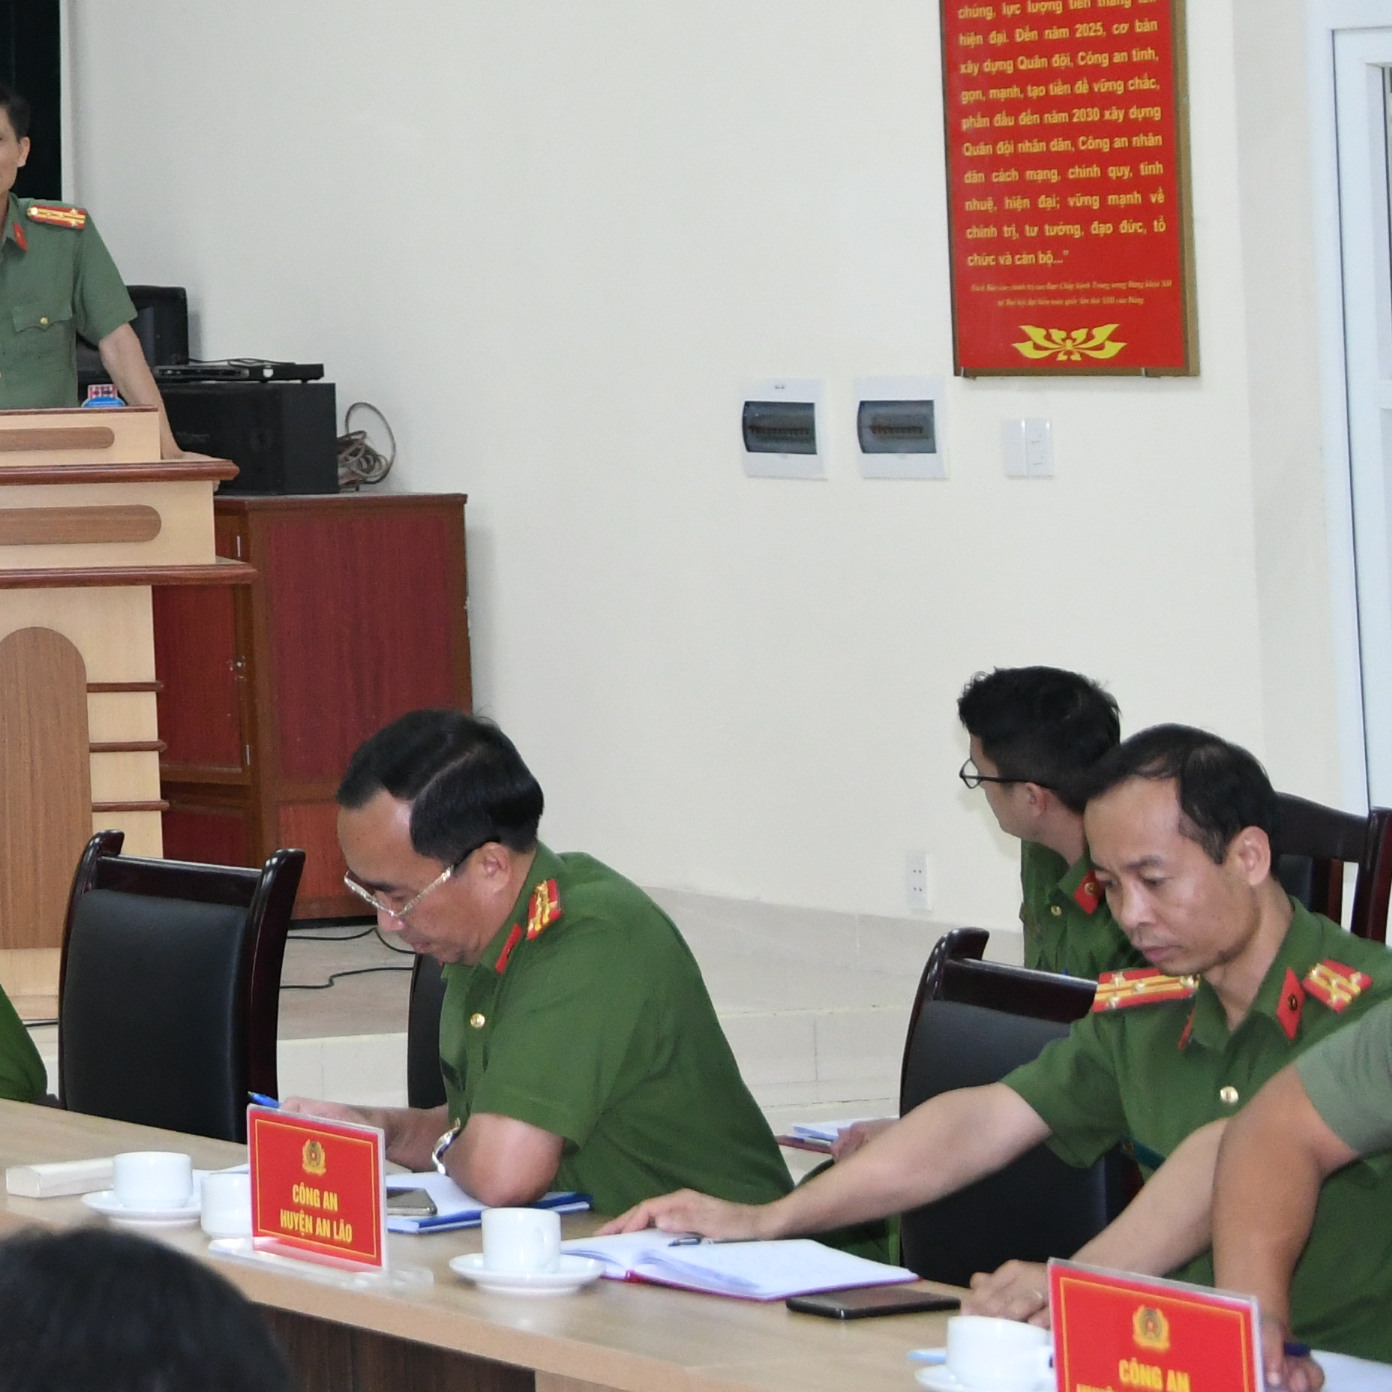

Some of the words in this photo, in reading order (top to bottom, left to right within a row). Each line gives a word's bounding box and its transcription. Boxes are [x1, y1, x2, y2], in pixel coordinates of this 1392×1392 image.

[292, 1182, 320, 1207] CÔNG
[323, 1192, 338, 1211] AN
[280, 1209, 313, 1236] HUYỆN
[315, 1218, 330, 1238] AN
[333, 1219, 353, 1243] LÃO
[1118, 1357, 1162, 1390] CÔNG
[1167, 1369, 1190, 1392] AN
